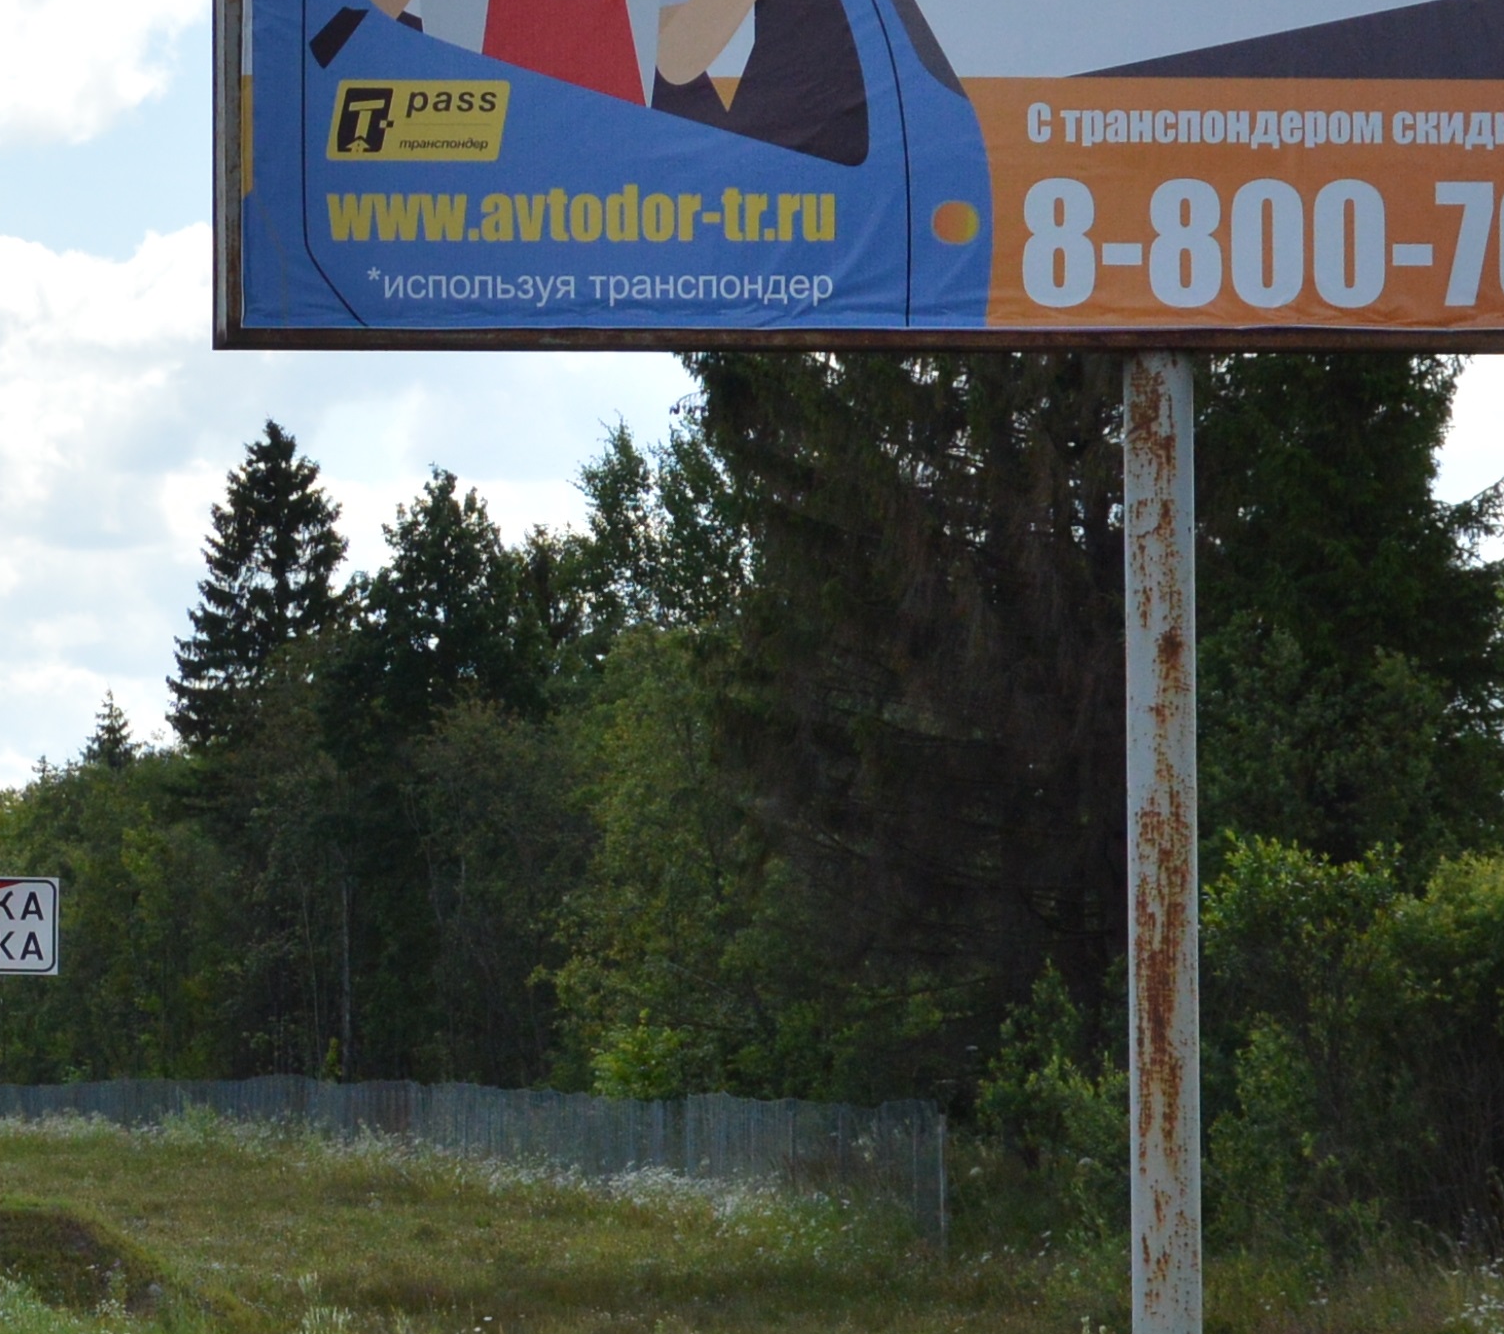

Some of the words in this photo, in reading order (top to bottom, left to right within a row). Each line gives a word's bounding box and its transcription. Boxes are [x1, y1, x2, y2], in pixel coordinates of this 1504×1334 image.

[405, 90, 498, 119] pass
[1026, 102, 1052, 143] С
[1060, 105, 1384, 150] транспондером
[398, 137, 489, 152] транспондер
[325, 183, 836, 243] www.avtodor-tr.ru
[588, 273, 834, 308] транспондер
